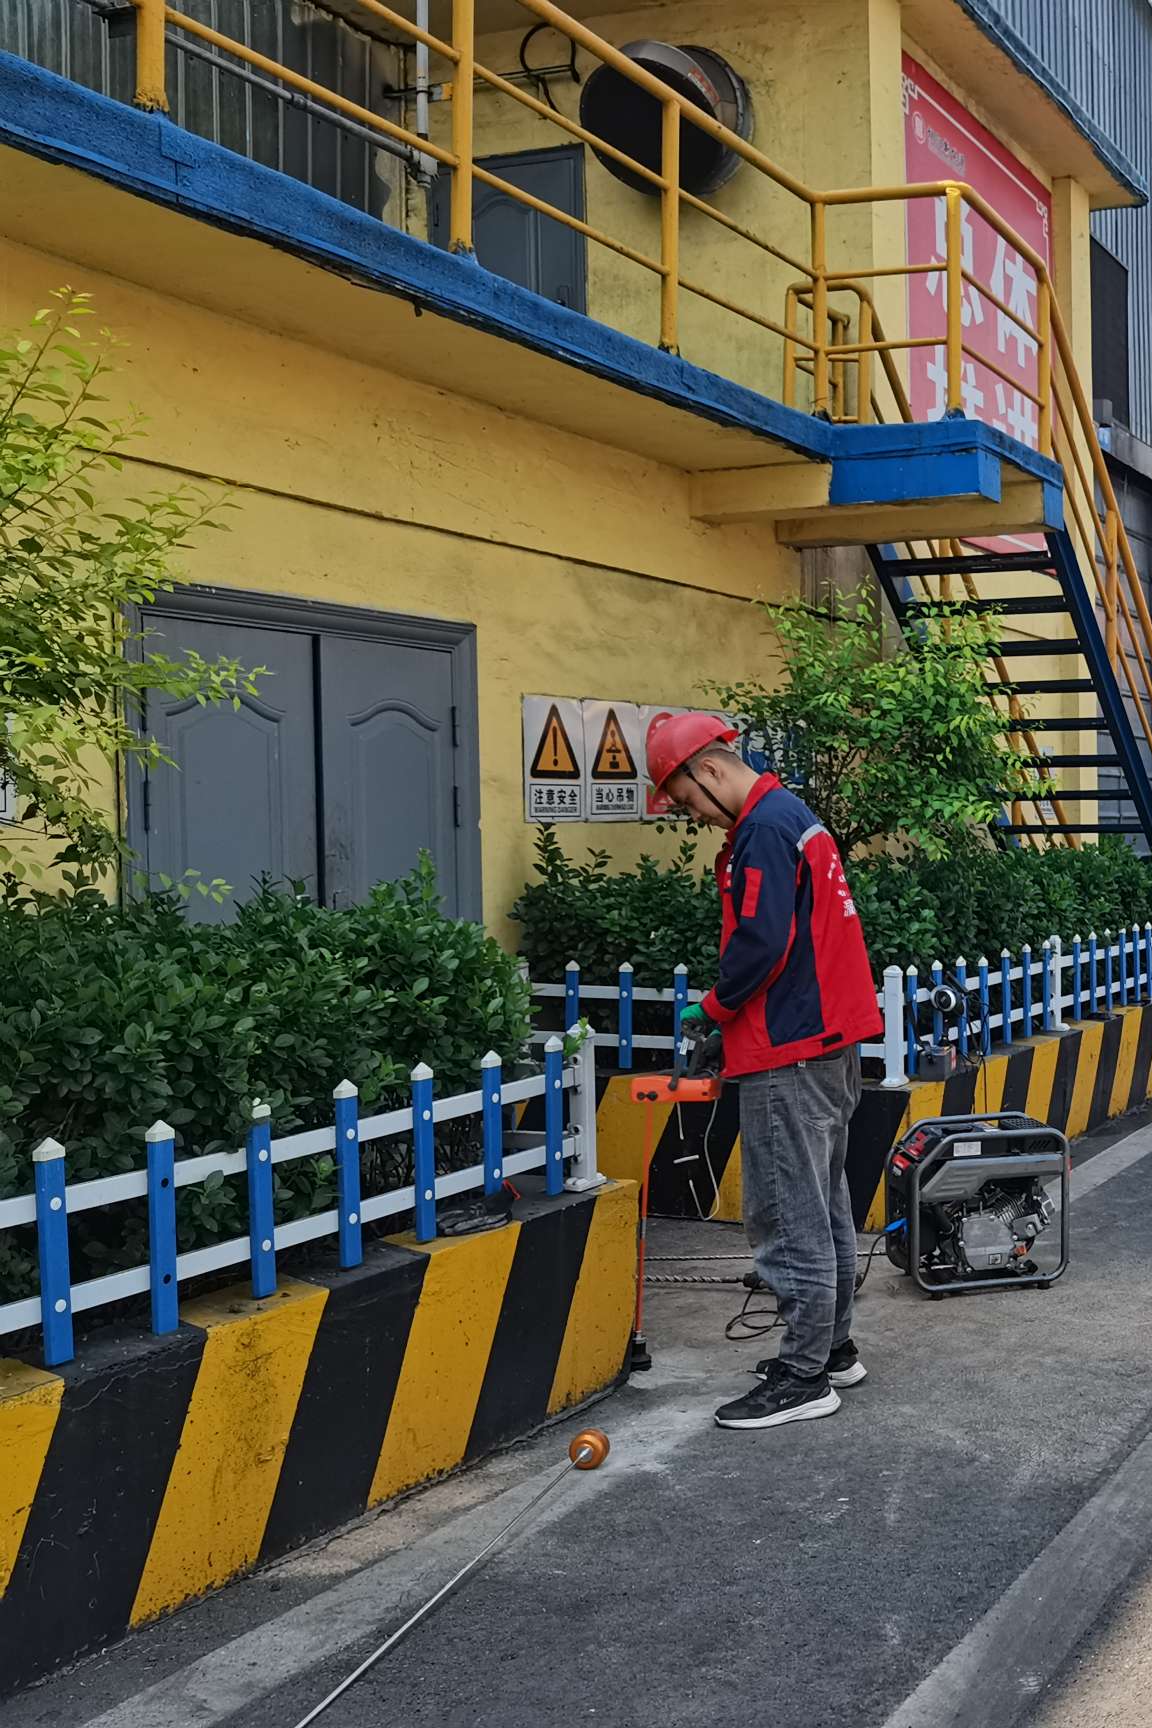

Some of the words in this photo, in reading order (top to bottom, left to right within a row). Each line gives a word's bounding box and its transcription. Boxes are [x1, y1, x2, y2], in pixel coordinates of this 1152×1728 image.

[534, 788, 578, 805] 注意安全
[595, 787, 635, 803] 当心吊物
